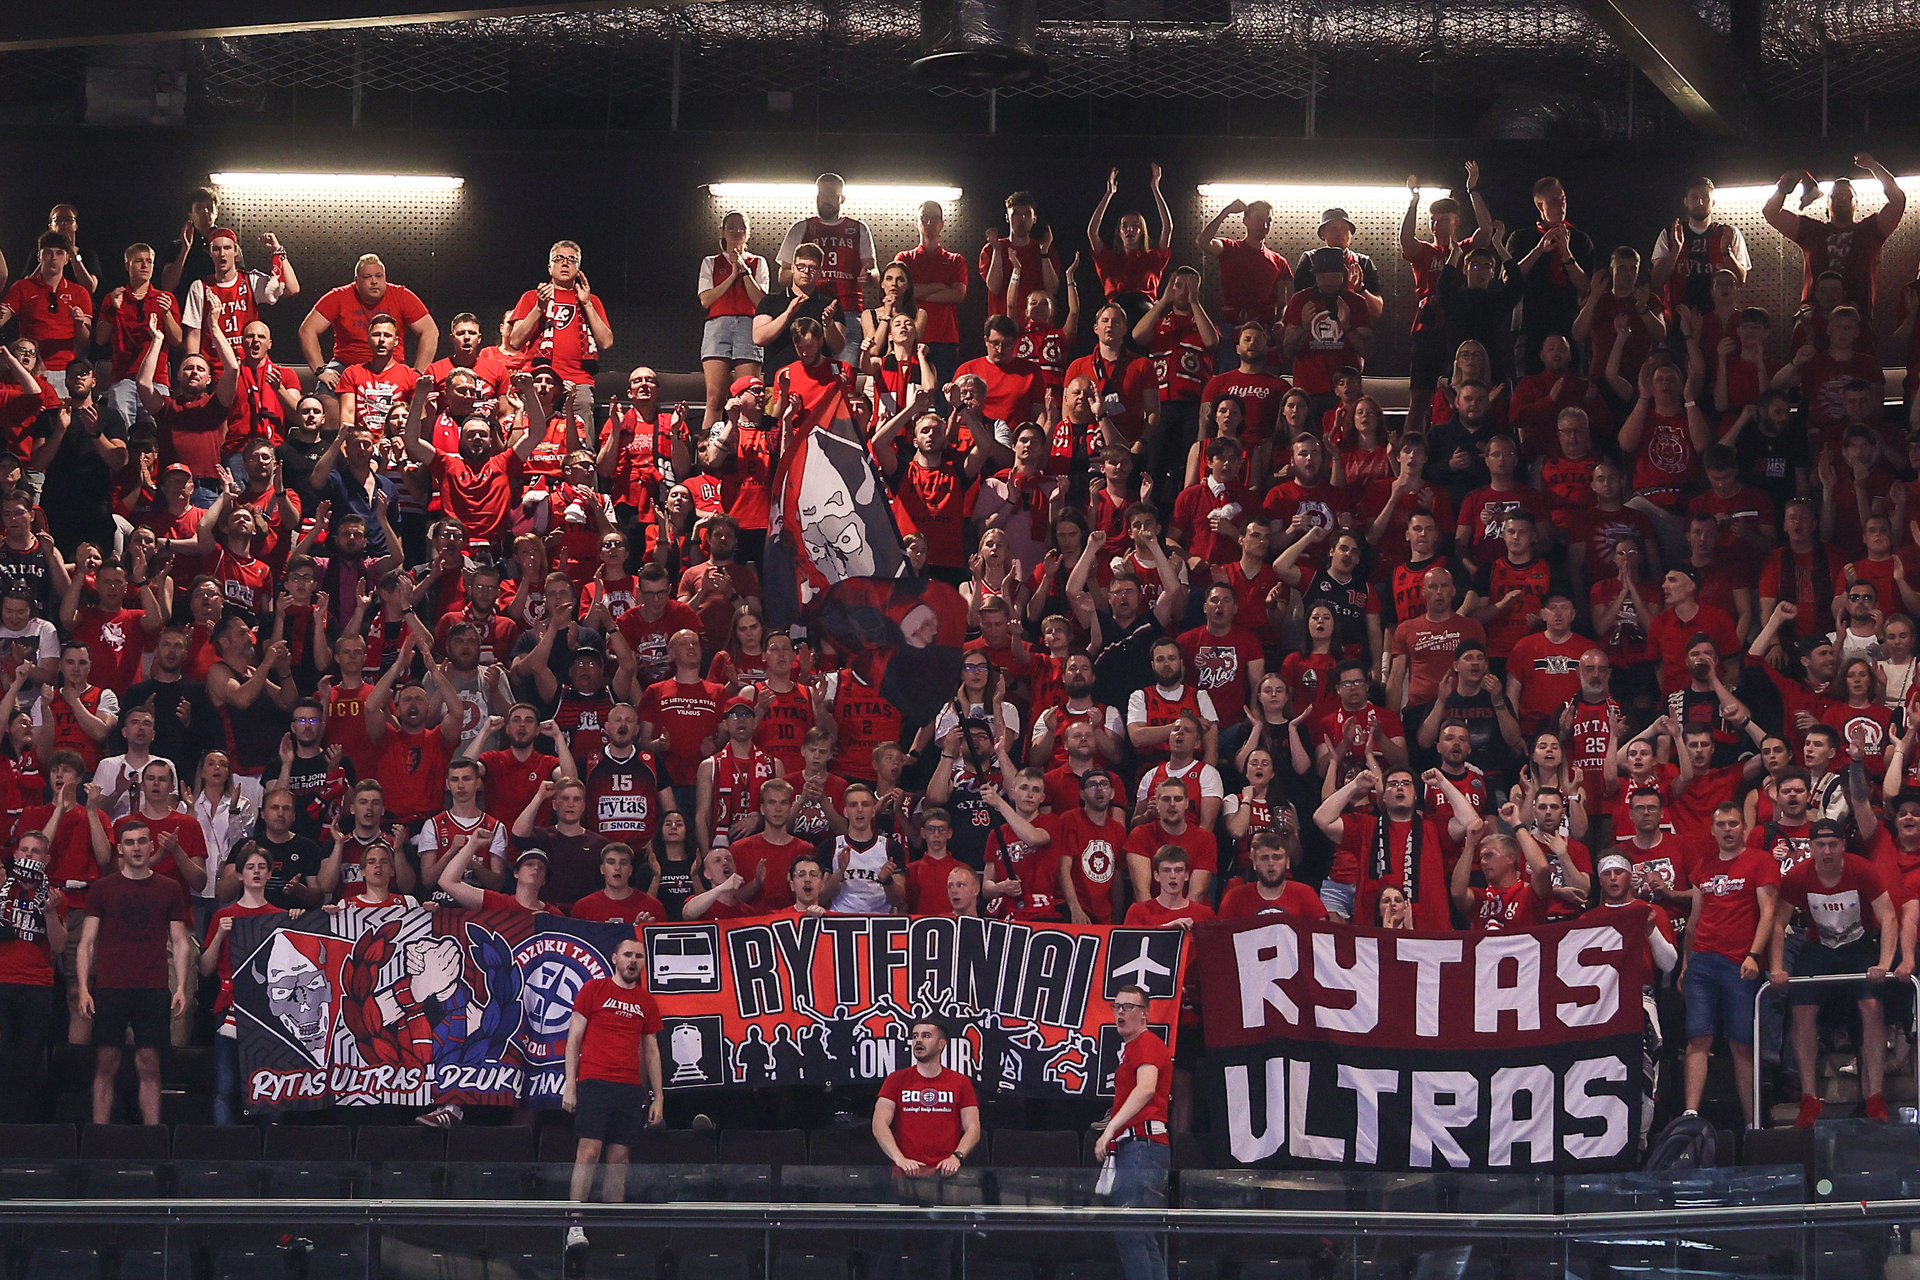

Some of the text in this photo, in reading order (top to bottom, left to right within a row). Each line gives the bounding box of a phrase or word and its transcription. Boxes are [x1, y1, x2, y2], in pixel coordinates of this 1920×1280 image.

[829, 252, 838, 266] 3
[218, 300, 247, 315] YTAS
[1228, 385, 1270, 399] Rytas
[1484, 520, 1507, 540] Ryt
[1140, 583, 1164, 596] YTA
[1347, 589, 1367, 608] 15
[1198, 667, 1236, 689] Rytas
[764, 706, 807, 722] RYTAS
[843, 703, 892, 718] RYTAS
[778, 724, 795, 739] 10
[863, 720, 872, 735] 2
[1573, 720, 1609, 737] RYTA
[1585, 737, 1606, 753] 25
[302, 780, 326, 788] FIGHT
[308, 773, 327, 781] JOIN
[612, 774, 632, 791] 15
[600, 801, 646, 817] rytas
[972, 809, 990, 826] 33
[611, 822, 646, 831] SNORAS
[843, 869, 881, 882] YTA
[1823, 903, 1844, 911] 1981
[517, 940, 567, 965] DZŪKŲ
[727, 916, 1101, 1030] RYTFANIAI
[1233, 924, 1623, 1036] RYTAS
[602, 998, 645, 1017] ULTRAS
[862, 1038, 896, 1079] ON
[252, 1071, 327, 1101] RYTAS
[331, 1065, 422, 1092] ULTRAS
[439, 1058, 525, 1099] DZŪKŲ
[1225, 1056, 1629, 1168] ULTRAS
